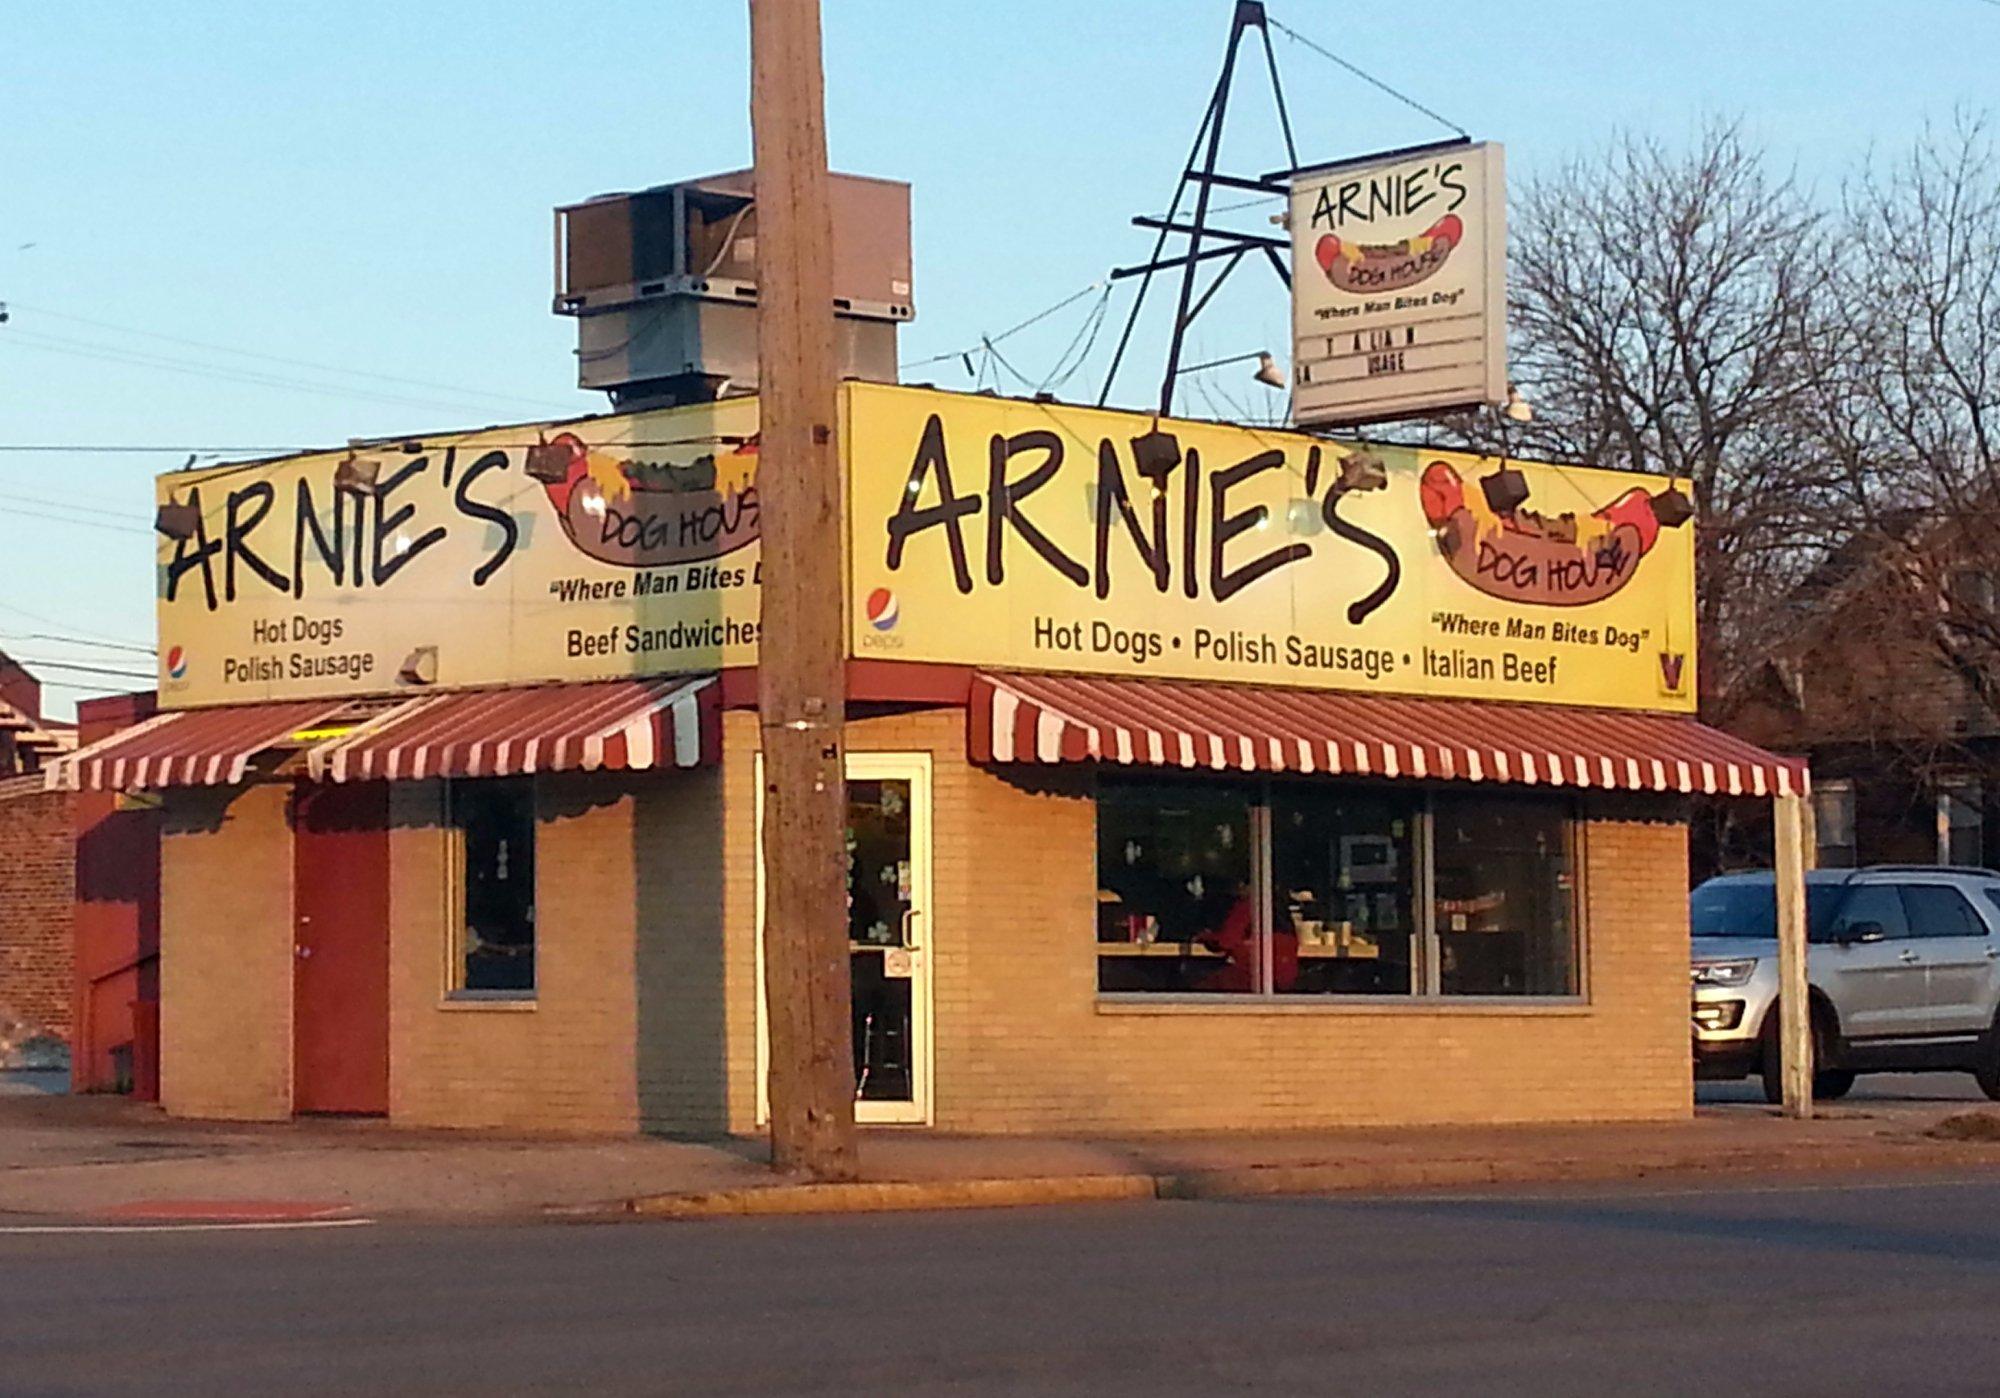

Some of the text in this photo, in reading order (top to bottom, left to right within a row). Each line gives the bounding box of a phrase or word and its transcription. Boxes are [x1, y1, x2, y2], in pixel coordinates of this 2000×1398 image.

[1311, 163, 1467, 229] ARNIE'S
[1348, 265, 1385, 286] DOG
[1364, 301, 1391, 313] Man
[1395, 296, 1428, 310] Bites
[168, 446, 519, 611] ARNIE'S
[600, 487, 761, 550] DOG HOUS
[886, 413, 1401, 625] ARNIE'S
[632, 571, 679, 596] Man
[686, 565, 746, 591] Bites
[1477, 536, 1631, 592] DOG HOUSE
[253, 614, 344, 646] Hot Dogs
[567, 625, 620, 658] Beef
[1506, 616, 1546, 640] Man
[1551, 621, 1599, 646] Bites
[1034, 616, 1557, 684] Hot Dogs Polish Sausage Italian Beef
[223, 652, 374, 684] Polish Sausage
